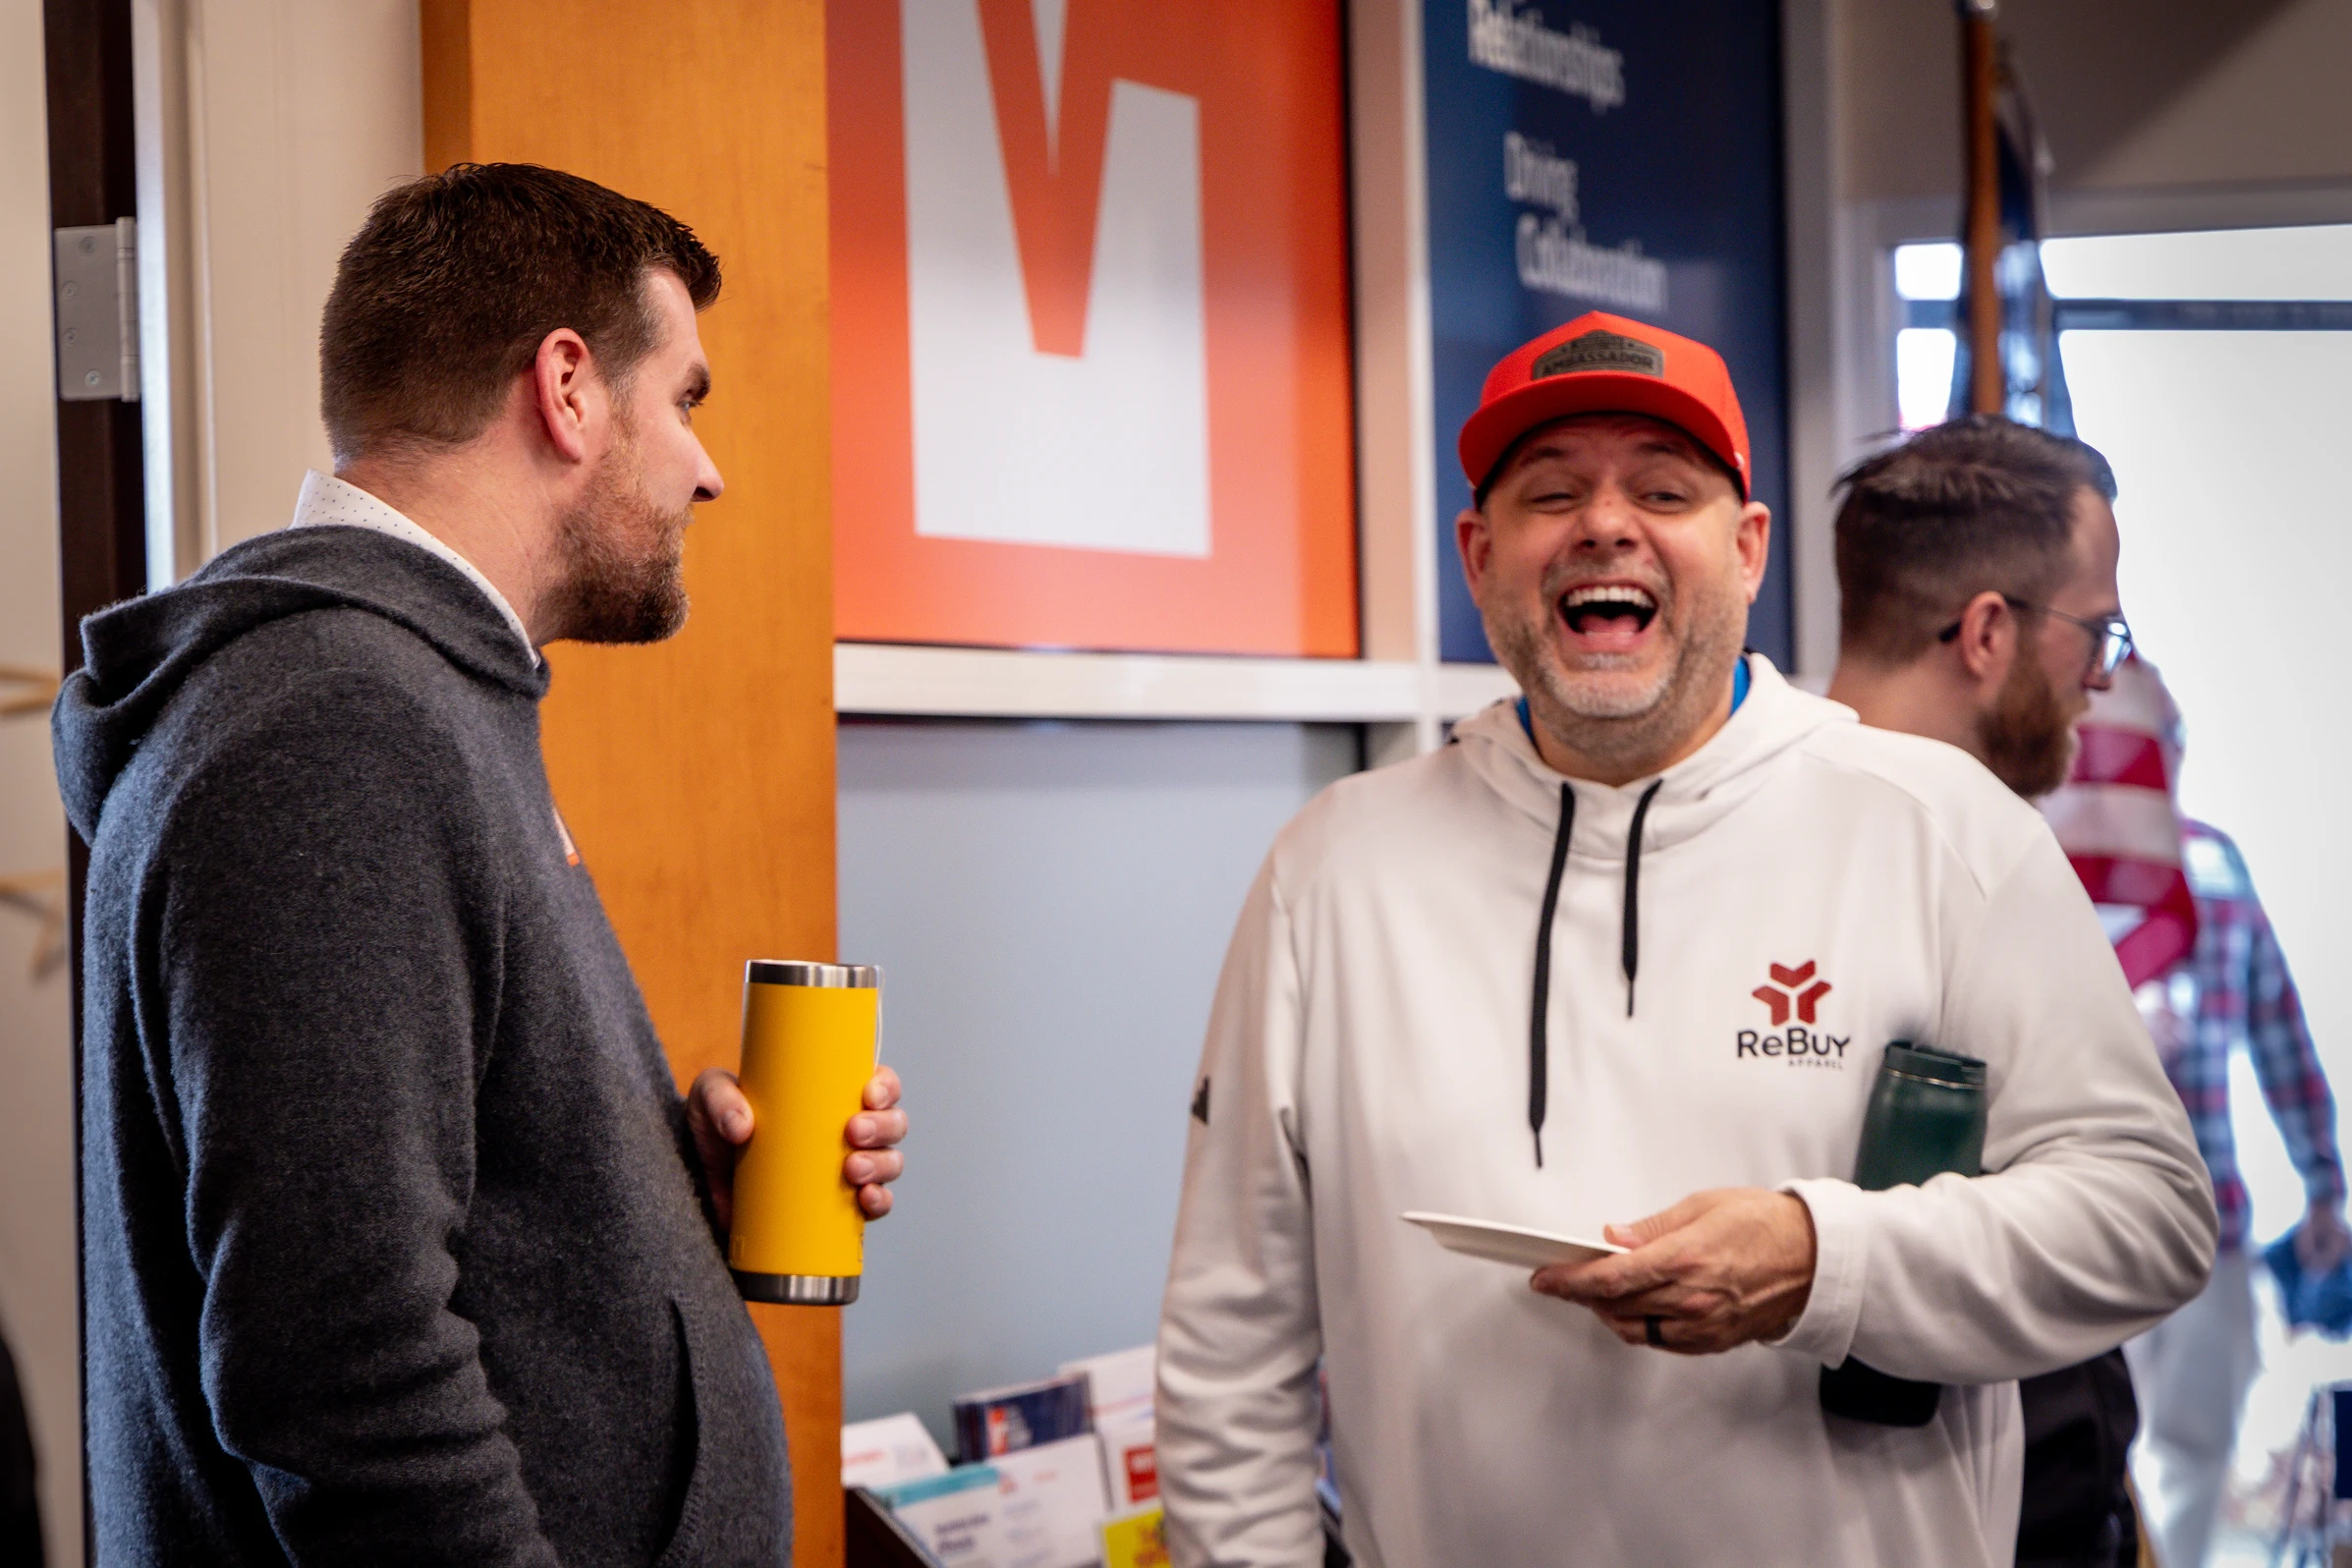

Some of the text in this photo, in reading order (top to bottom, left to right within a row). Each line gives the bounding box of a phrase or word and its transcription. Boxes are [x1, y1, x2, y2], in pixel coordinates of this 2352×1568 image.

[1502, 131, 1579, 223] Driving
[1516, 213, 1669, 313] Collaboration
[1541, 350, 1654, 376] AMBASSADOR
[1788, 1059, 1843, 1070] APPAREL
